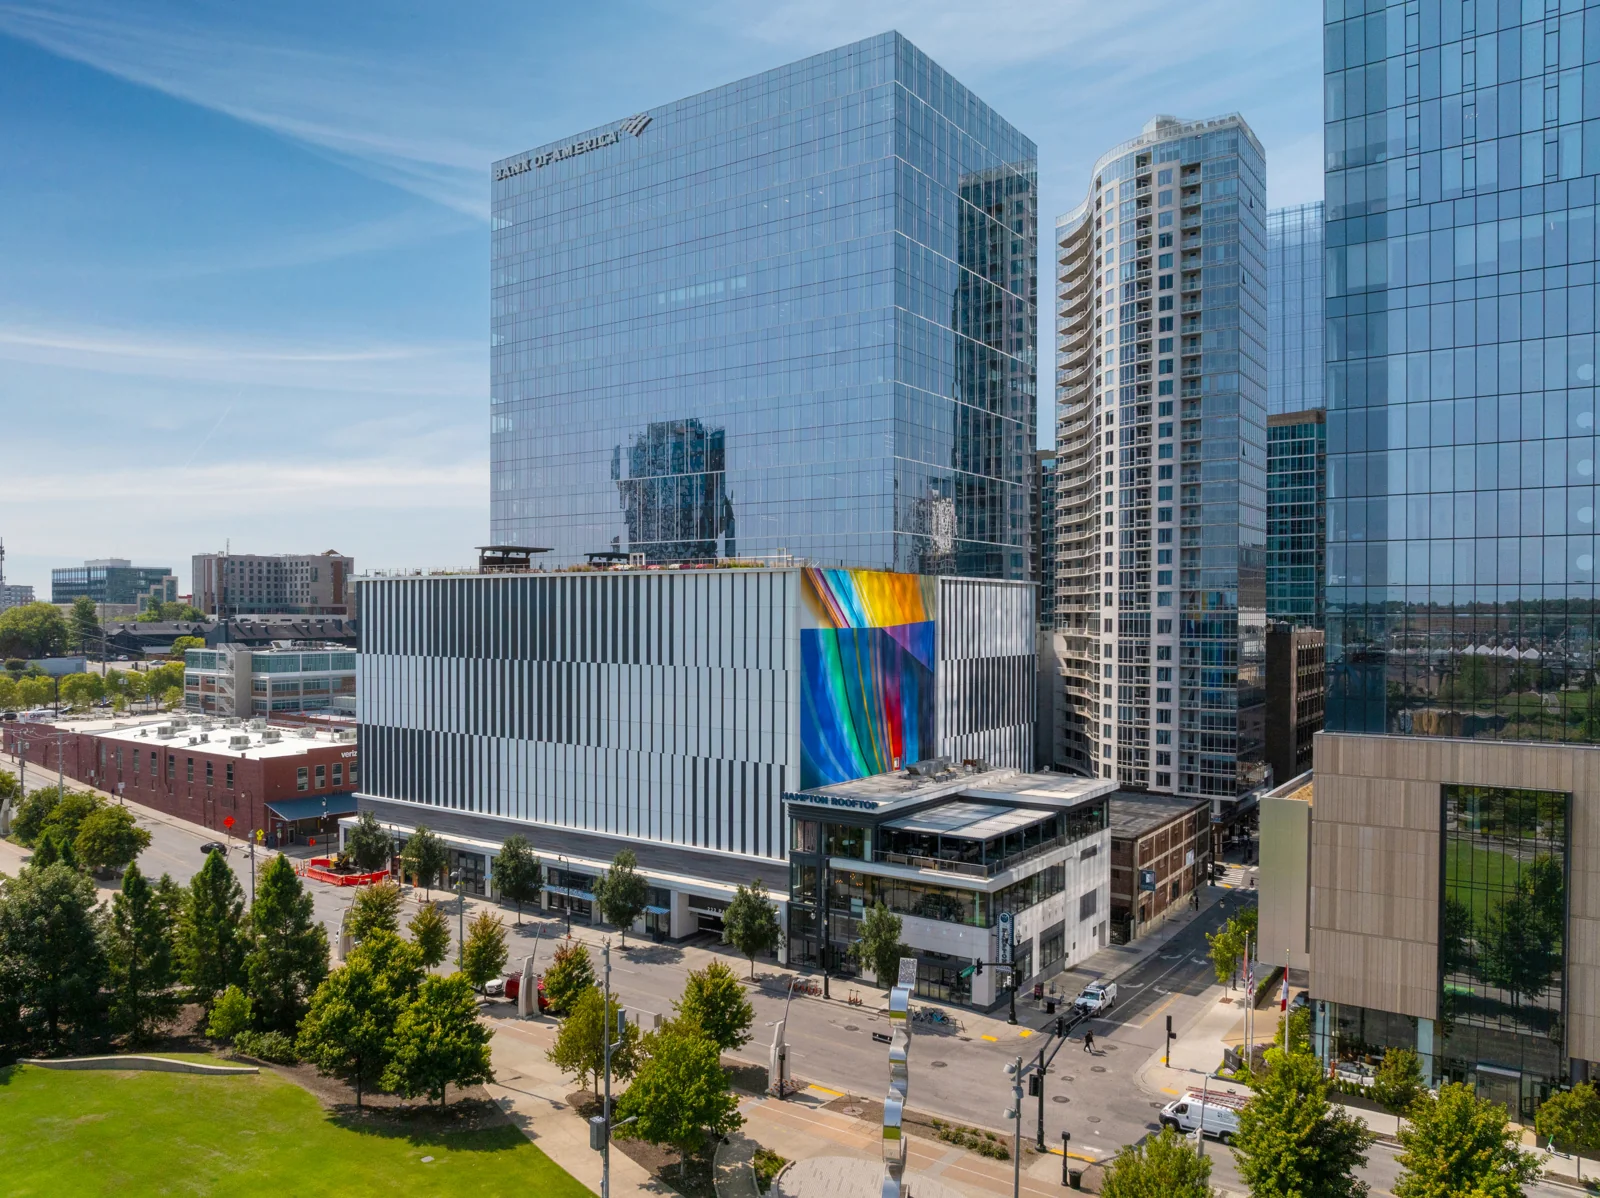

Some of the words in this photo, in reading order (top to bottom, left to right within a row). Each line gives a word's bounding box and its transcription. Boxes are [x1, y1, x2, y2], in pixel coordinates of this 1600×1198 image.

[495, 160, 531, 181] BANK
[535, 152, 554, 168] OF
[551, 131, 619, 162] AMERICA
[341, 750, 358, 759] veriz
[782, 791, 828, 805] HAMPTON
[830, 797, 879, 810] ROOFTOP
